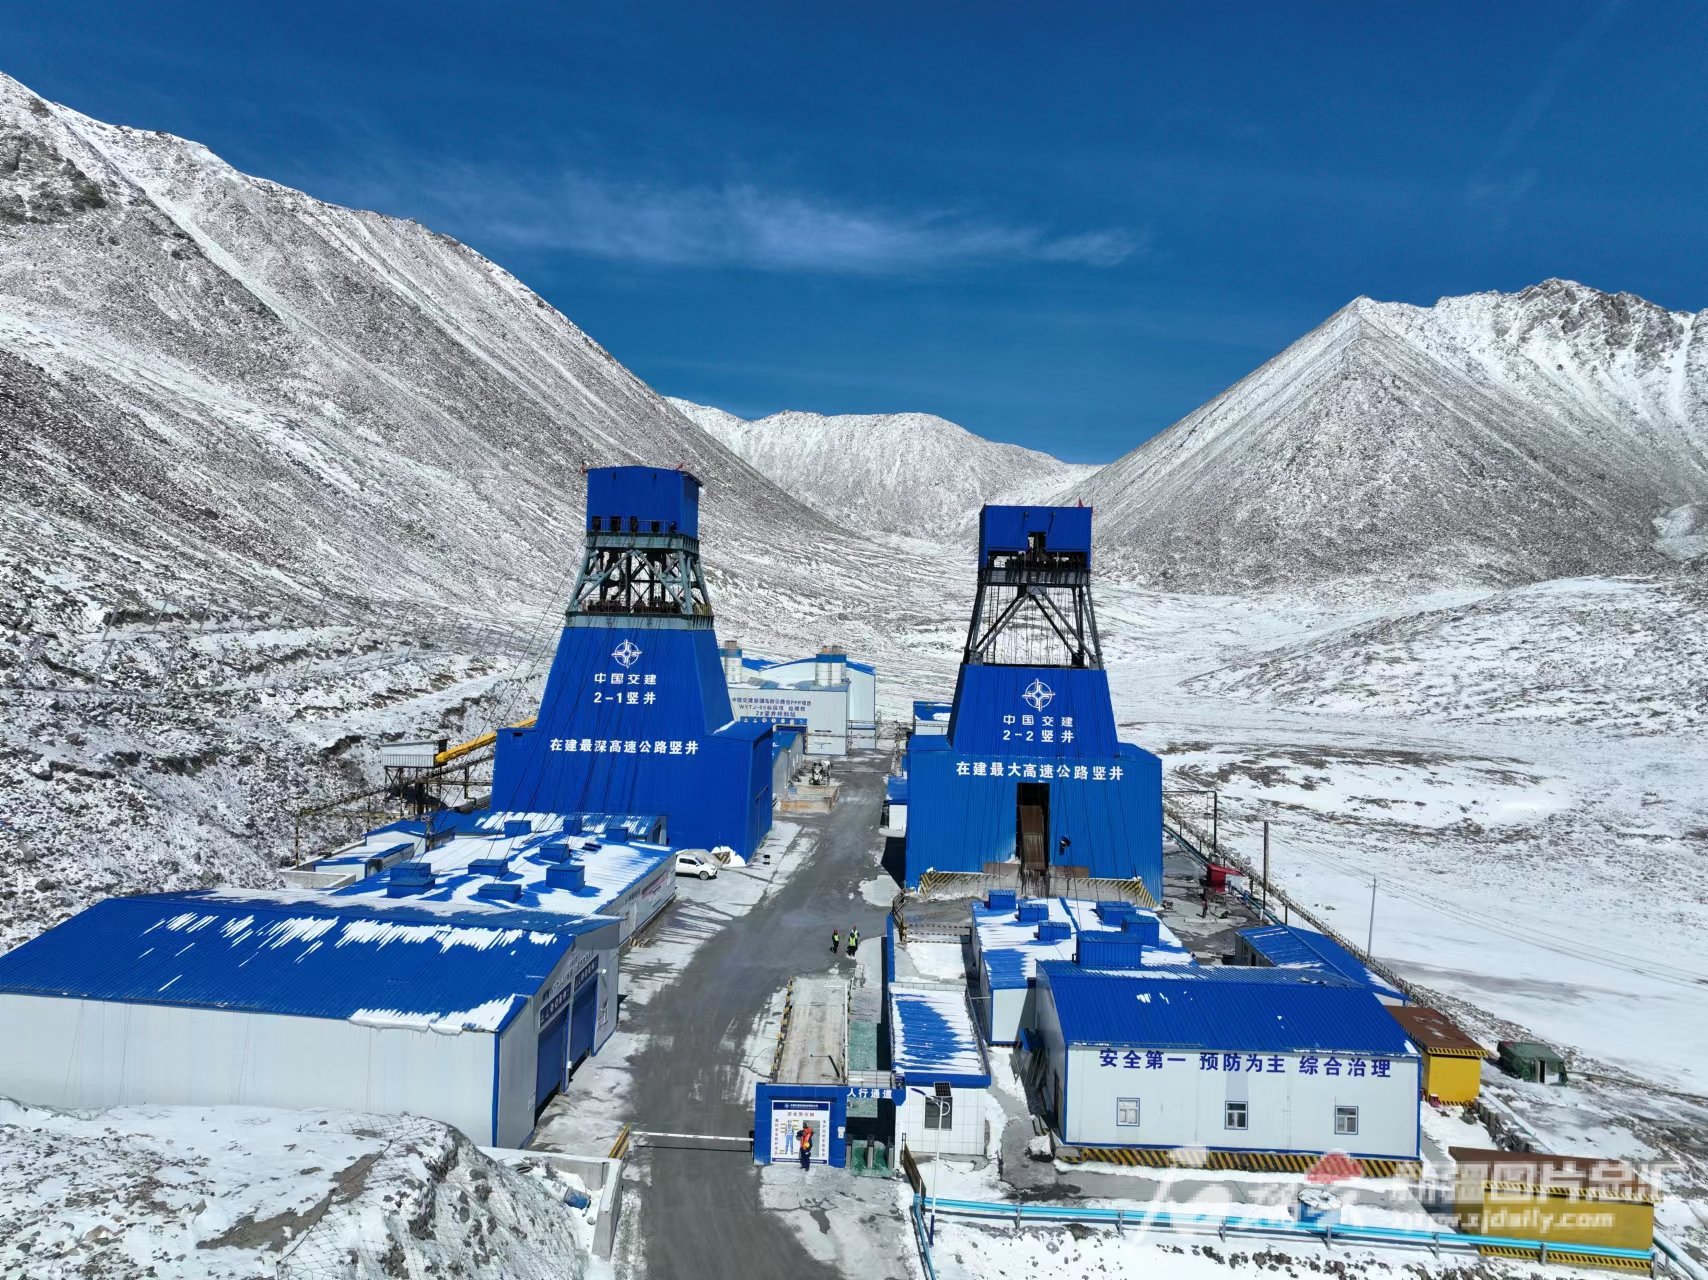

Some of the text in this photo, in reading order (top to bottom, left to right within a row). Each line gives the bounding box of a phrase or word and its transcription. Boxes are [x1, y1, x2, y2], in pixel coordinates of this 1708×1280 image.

[594, 672, 657, 685] 中国交建
[593, 691, 657, 705] 2-1竖井
[1003, 714, 1074, 727] 中国交建
[1003, 729, 1074, 743] 2-2竖井
[549, 738, 699, 755] 在建最深高速公路竖井
[956, 761, 1124, 781] 在建最大高速公路竖井
[1099, 1047, 1392, 1078] 安全第一 预防为主 综合治理
[847, 1088, 893, 1099] 人行通道
